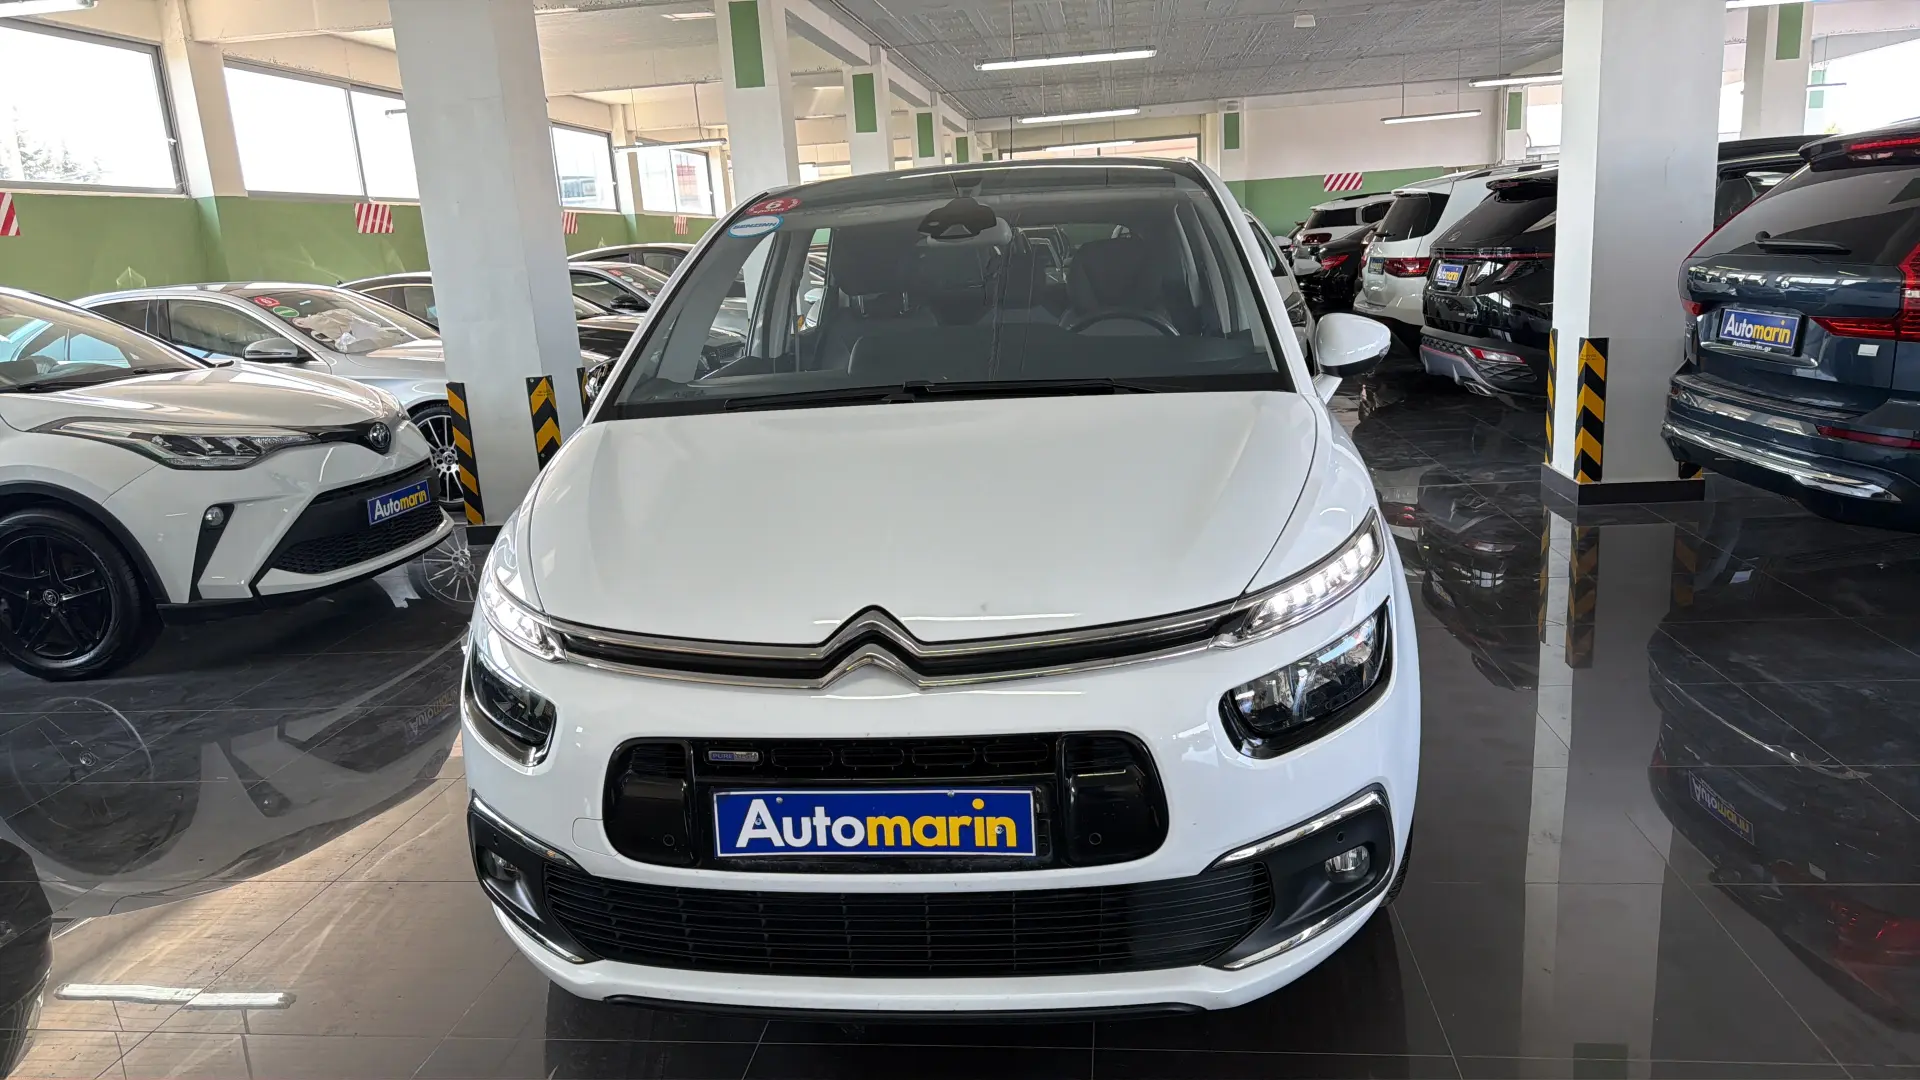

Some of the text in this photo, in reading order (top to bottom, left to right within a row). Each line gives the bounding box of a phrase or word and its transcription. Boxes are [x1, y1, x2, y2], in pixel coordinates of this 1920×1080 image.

[1723, 313, 1791, 344] Automarin
[1731, 340, 1772, 352] Automarin.gr
[374, 485, 427, 520] Automarin
[735, 798, 1017, 848] Automarin
